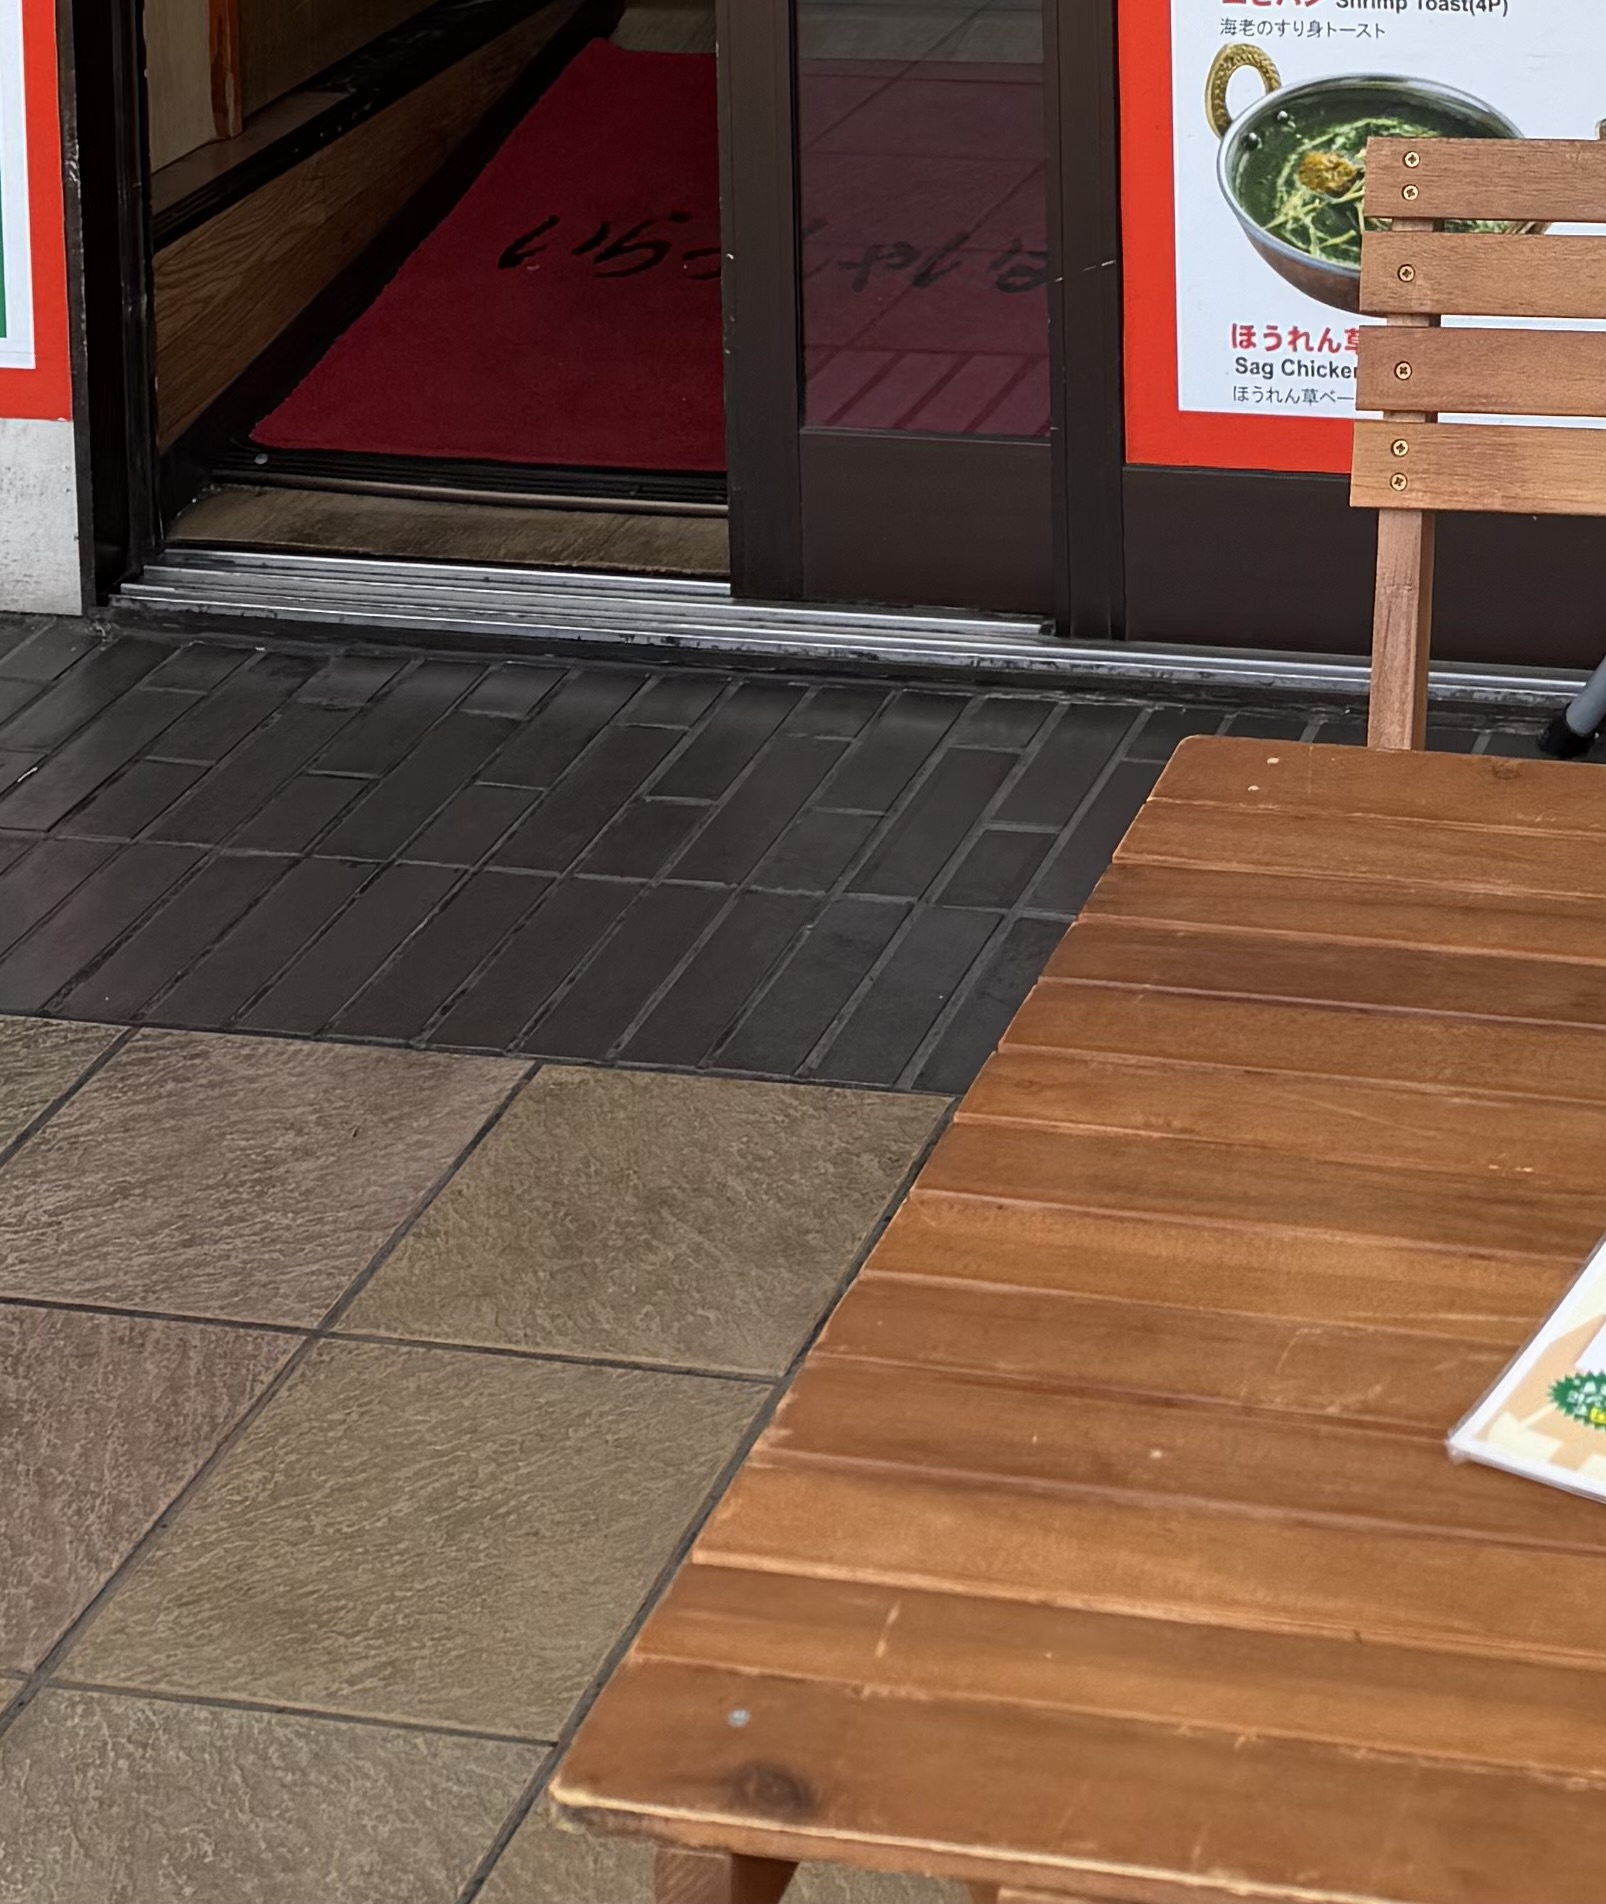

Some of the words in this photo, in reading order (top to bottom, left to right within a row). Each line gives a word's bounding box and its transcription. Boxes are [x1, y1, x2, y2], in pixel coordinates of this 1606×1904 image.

[1219, 16, 1386, 40] 海老のすり身トースト
[1234, 356, 1274, 380] Sag
[1232, 385, 1355, 406] ほうれん草ベー
